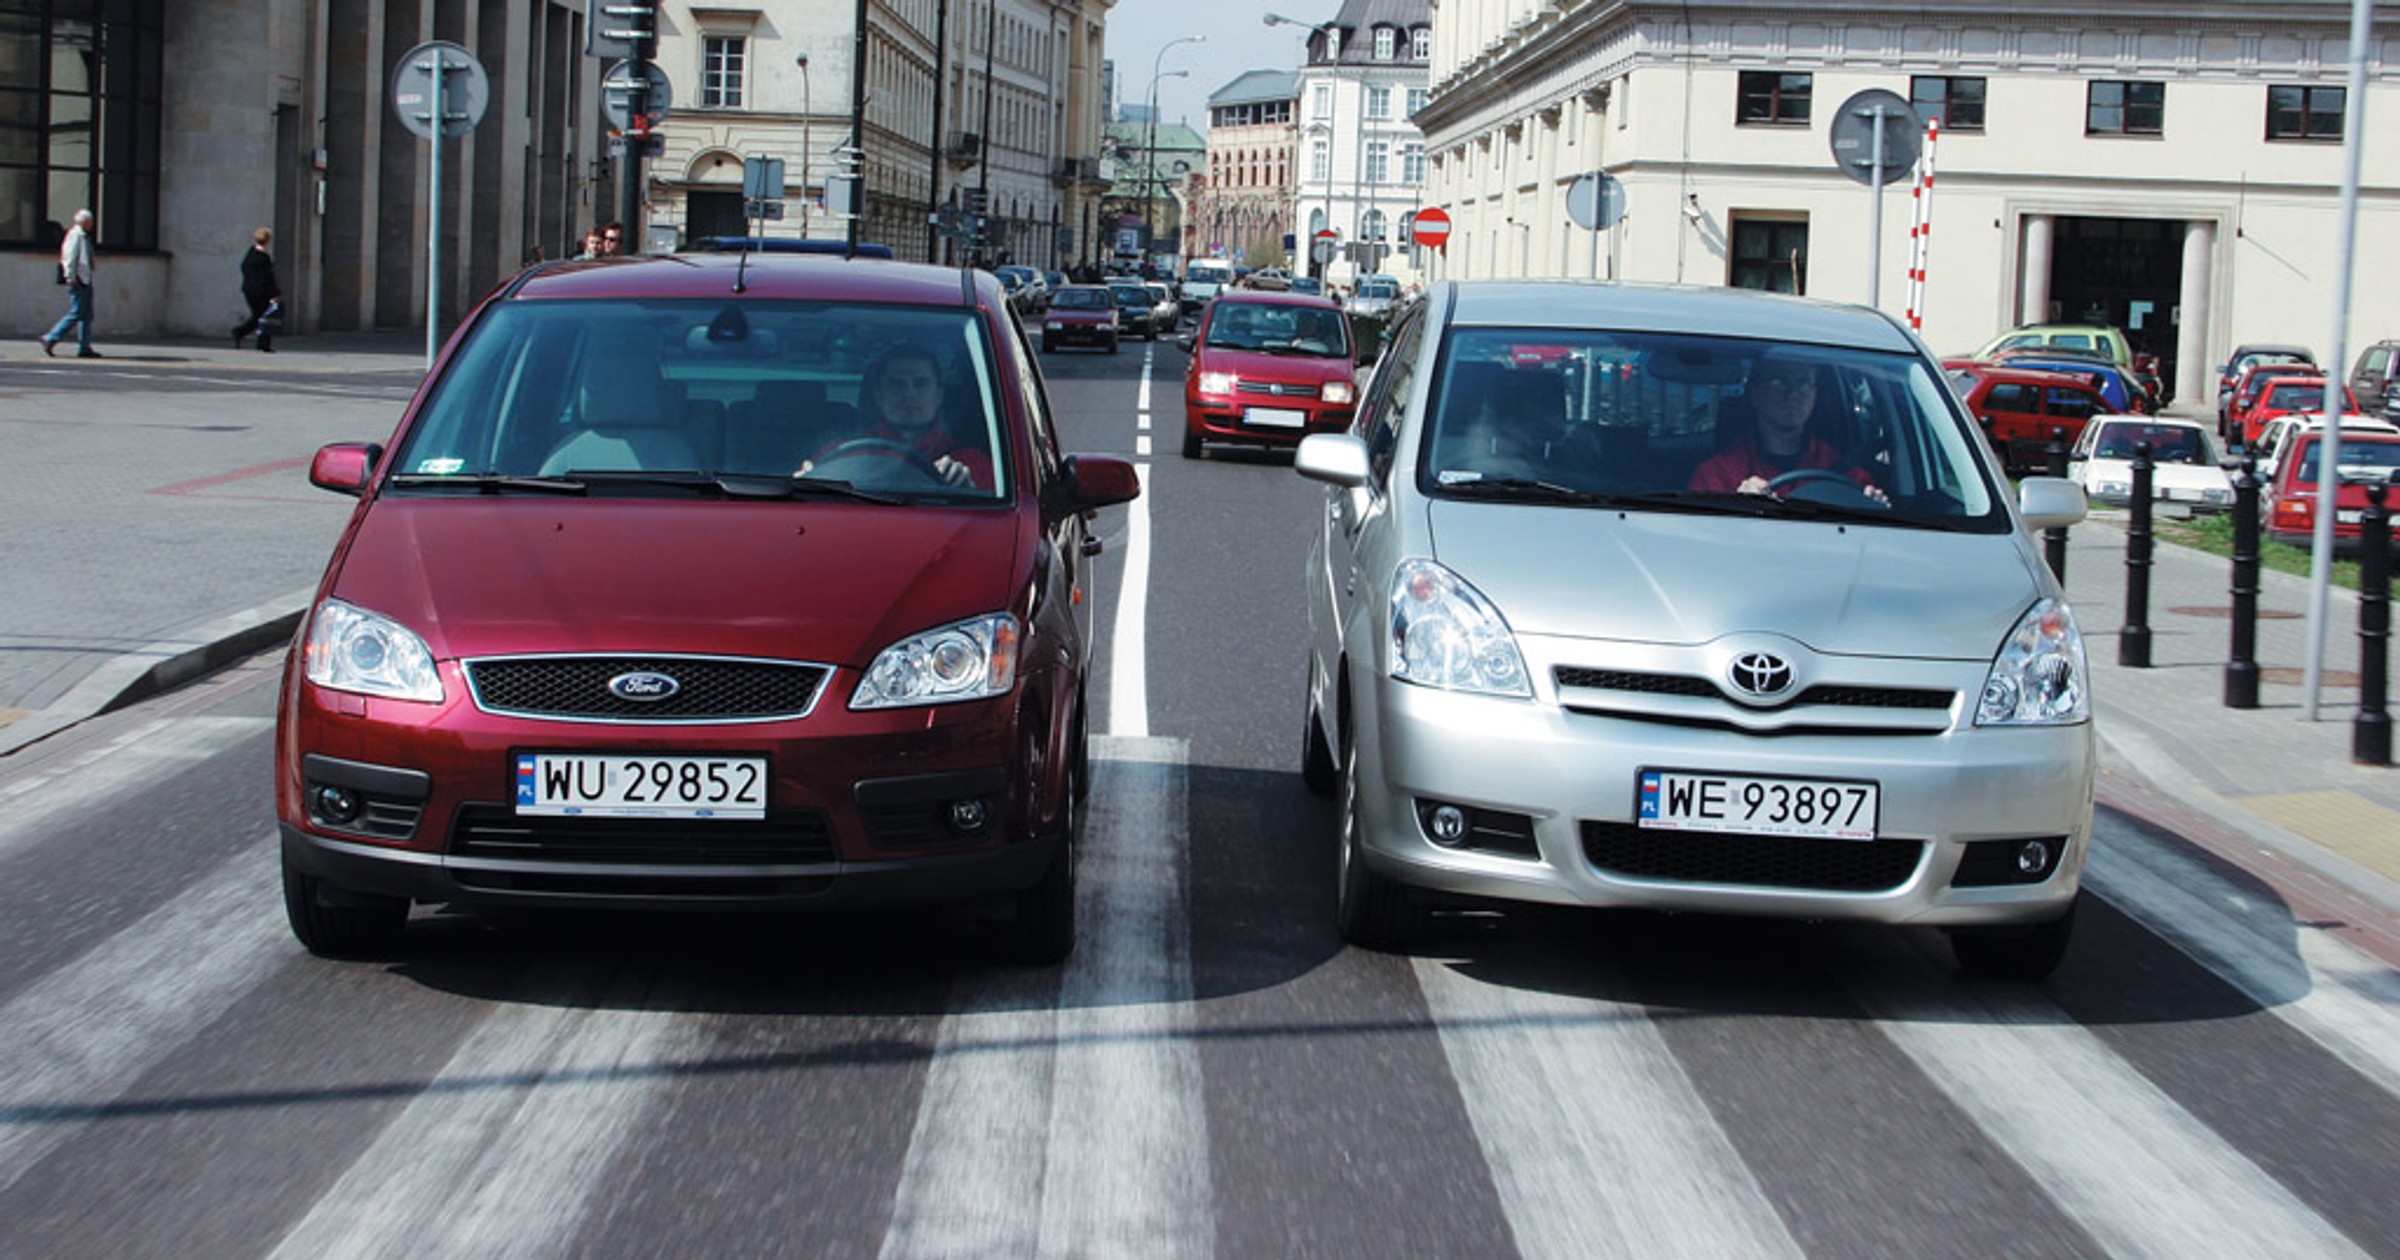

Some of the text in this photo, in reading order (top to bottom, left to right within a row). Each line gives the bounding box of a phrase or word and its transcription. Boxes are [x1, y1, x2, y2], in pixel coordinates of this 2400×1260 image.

[626, 676, 662, 692] Ford
[544, 760, 757, 802] WU 29852
[1642, 801, 1656, 812] PL
[1668, 778, 1867, 826] WE 93897
